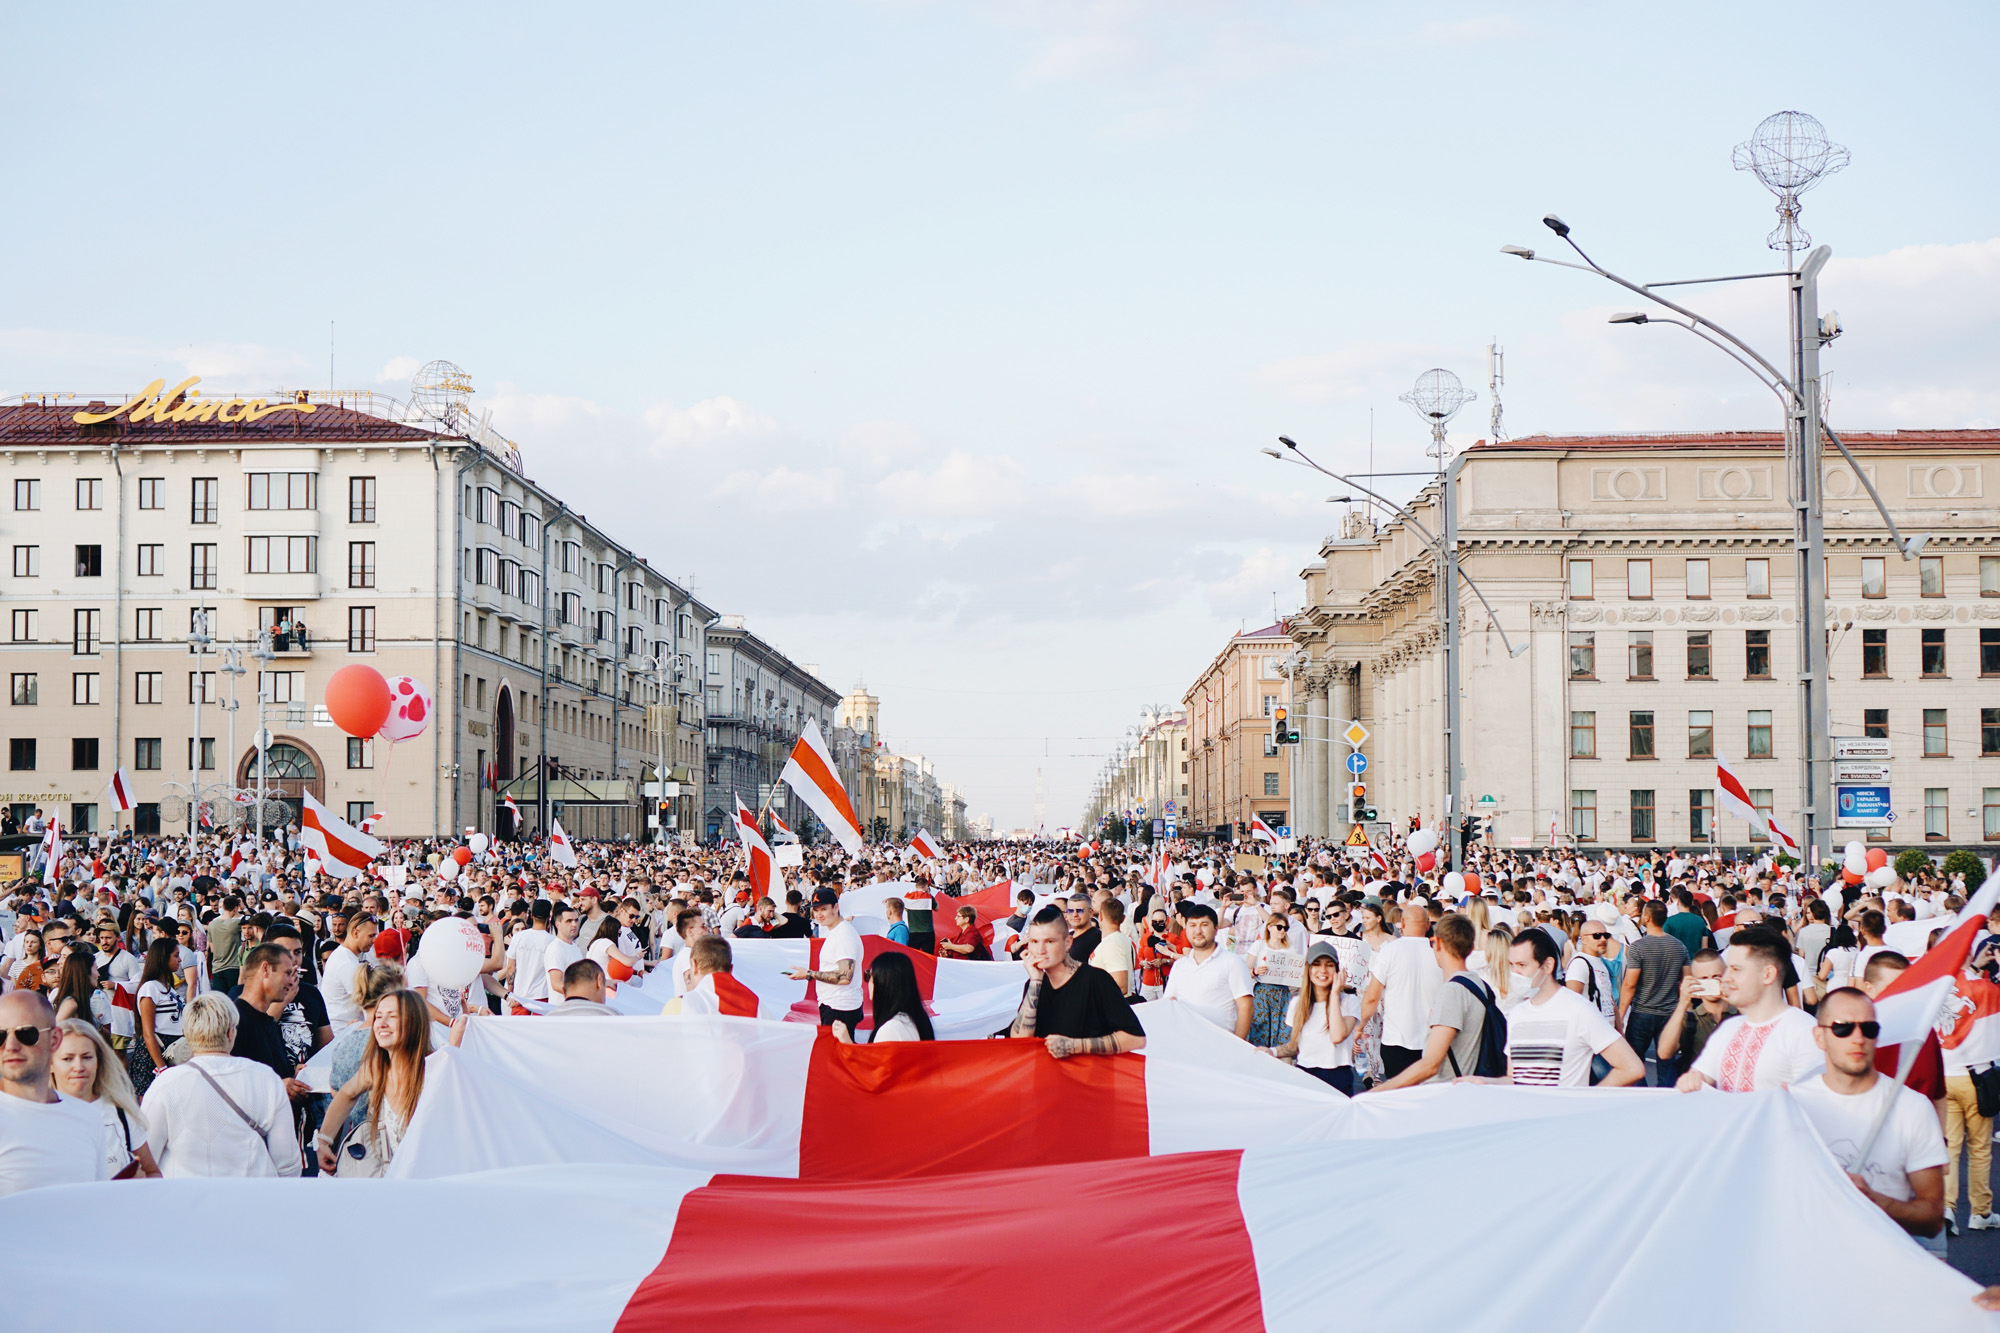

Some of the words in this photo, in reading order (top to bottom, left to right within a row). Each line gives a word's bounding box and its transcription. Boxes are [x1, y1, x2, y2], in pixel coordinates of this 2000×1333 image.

[286, 389, 373, 400] ГАСЦІНІЦА
[18, 793, 72, 801] КРАСОТЫ
[283, 1002, 305, 1012] AFIA
